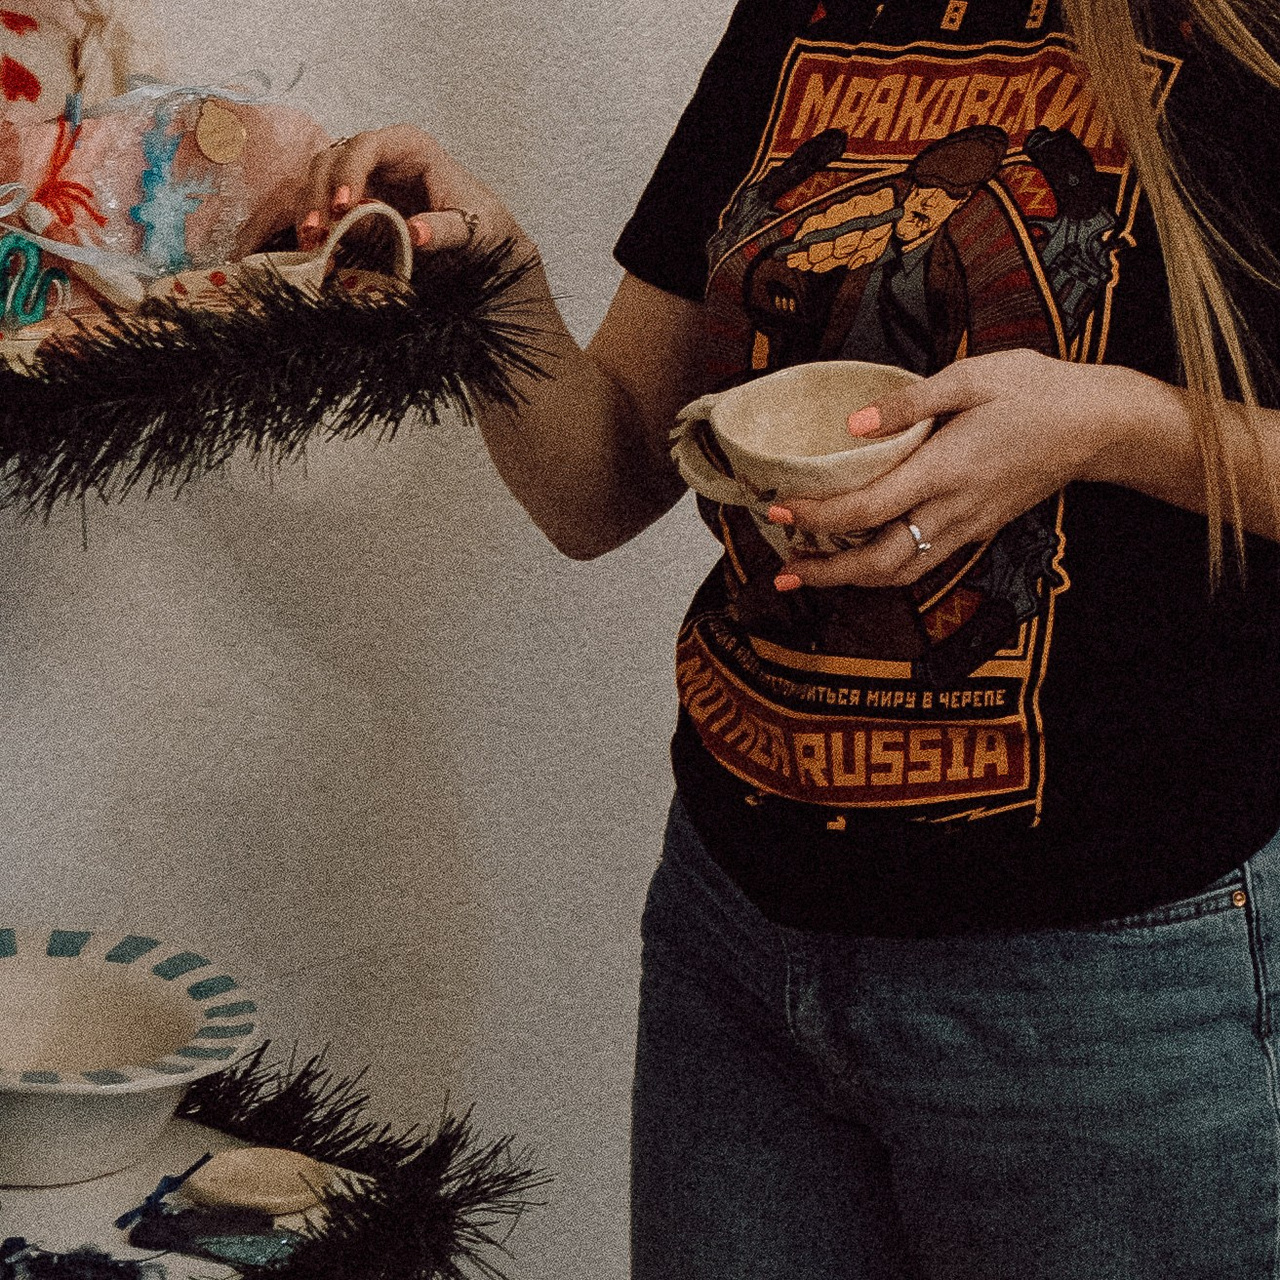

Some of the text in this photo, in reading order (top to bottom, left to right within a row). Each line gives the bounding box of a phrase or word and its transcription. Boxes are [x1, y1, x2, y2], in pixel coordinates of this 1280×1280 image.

[867, 689, 1006, 709] МИРУ В ЧЕРЕПЕ
[793, 728, 1009, 787] RUSSIA
